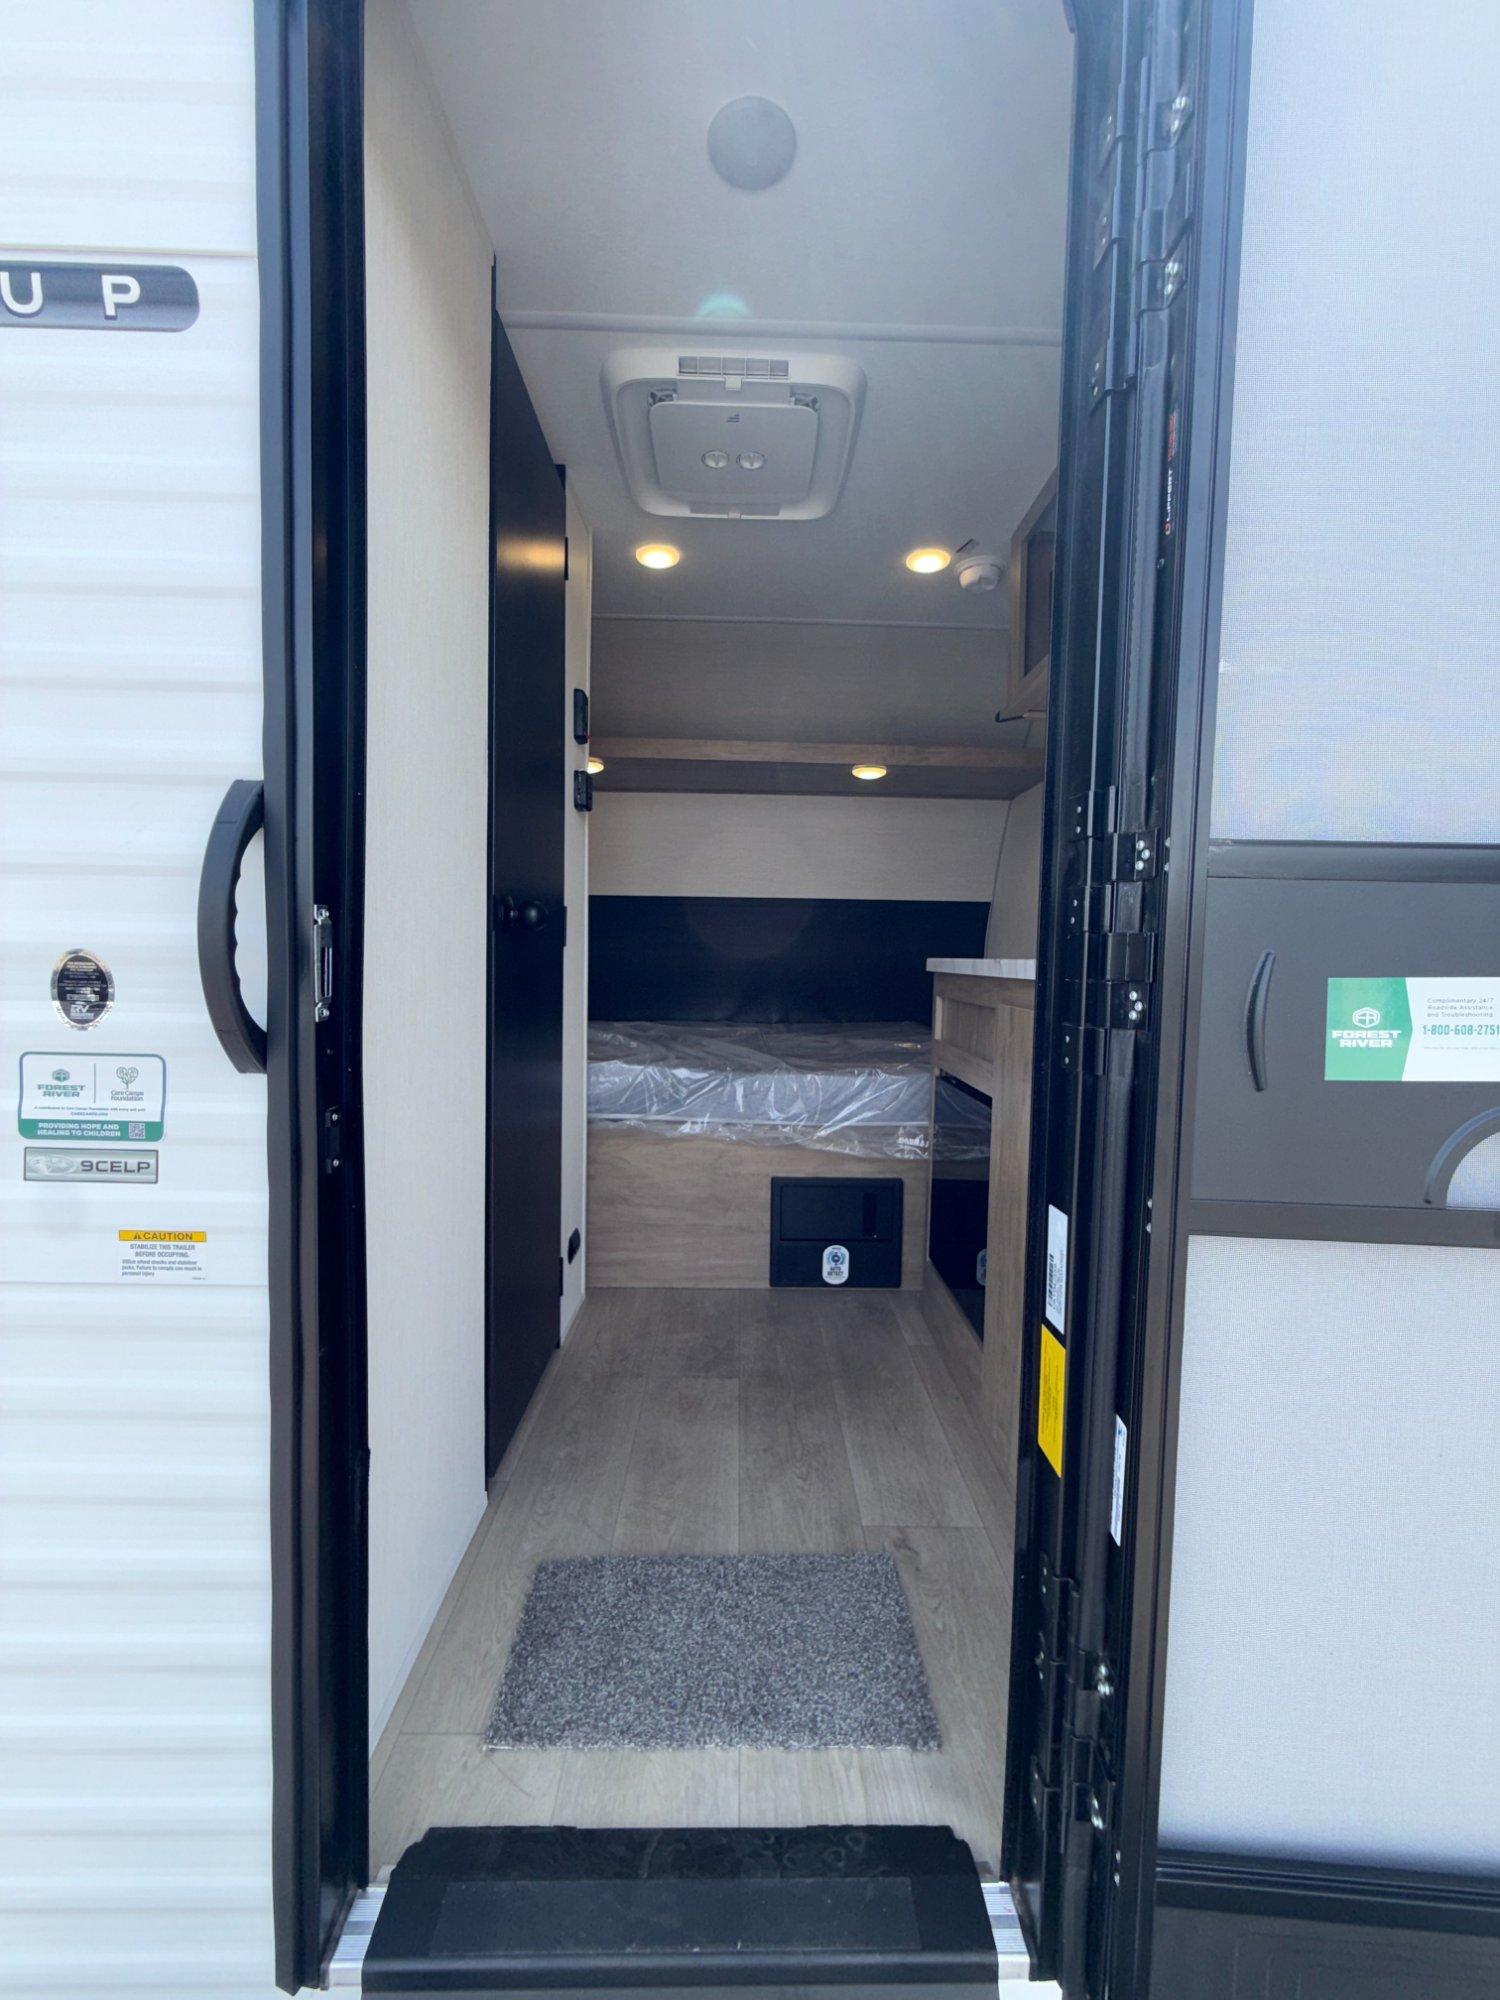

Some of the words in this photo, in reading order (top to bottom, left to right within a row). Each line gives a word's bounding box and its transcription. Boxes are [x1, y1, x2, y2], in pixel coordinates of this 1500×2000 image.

[1332, 1030, 1402, 1039] FOREST
[1340, 1040, 1393, 1048] RIVER
[80, 1160, 150, 1173] 9CELP
[144, 1232, 192, 1240] CAUTION
